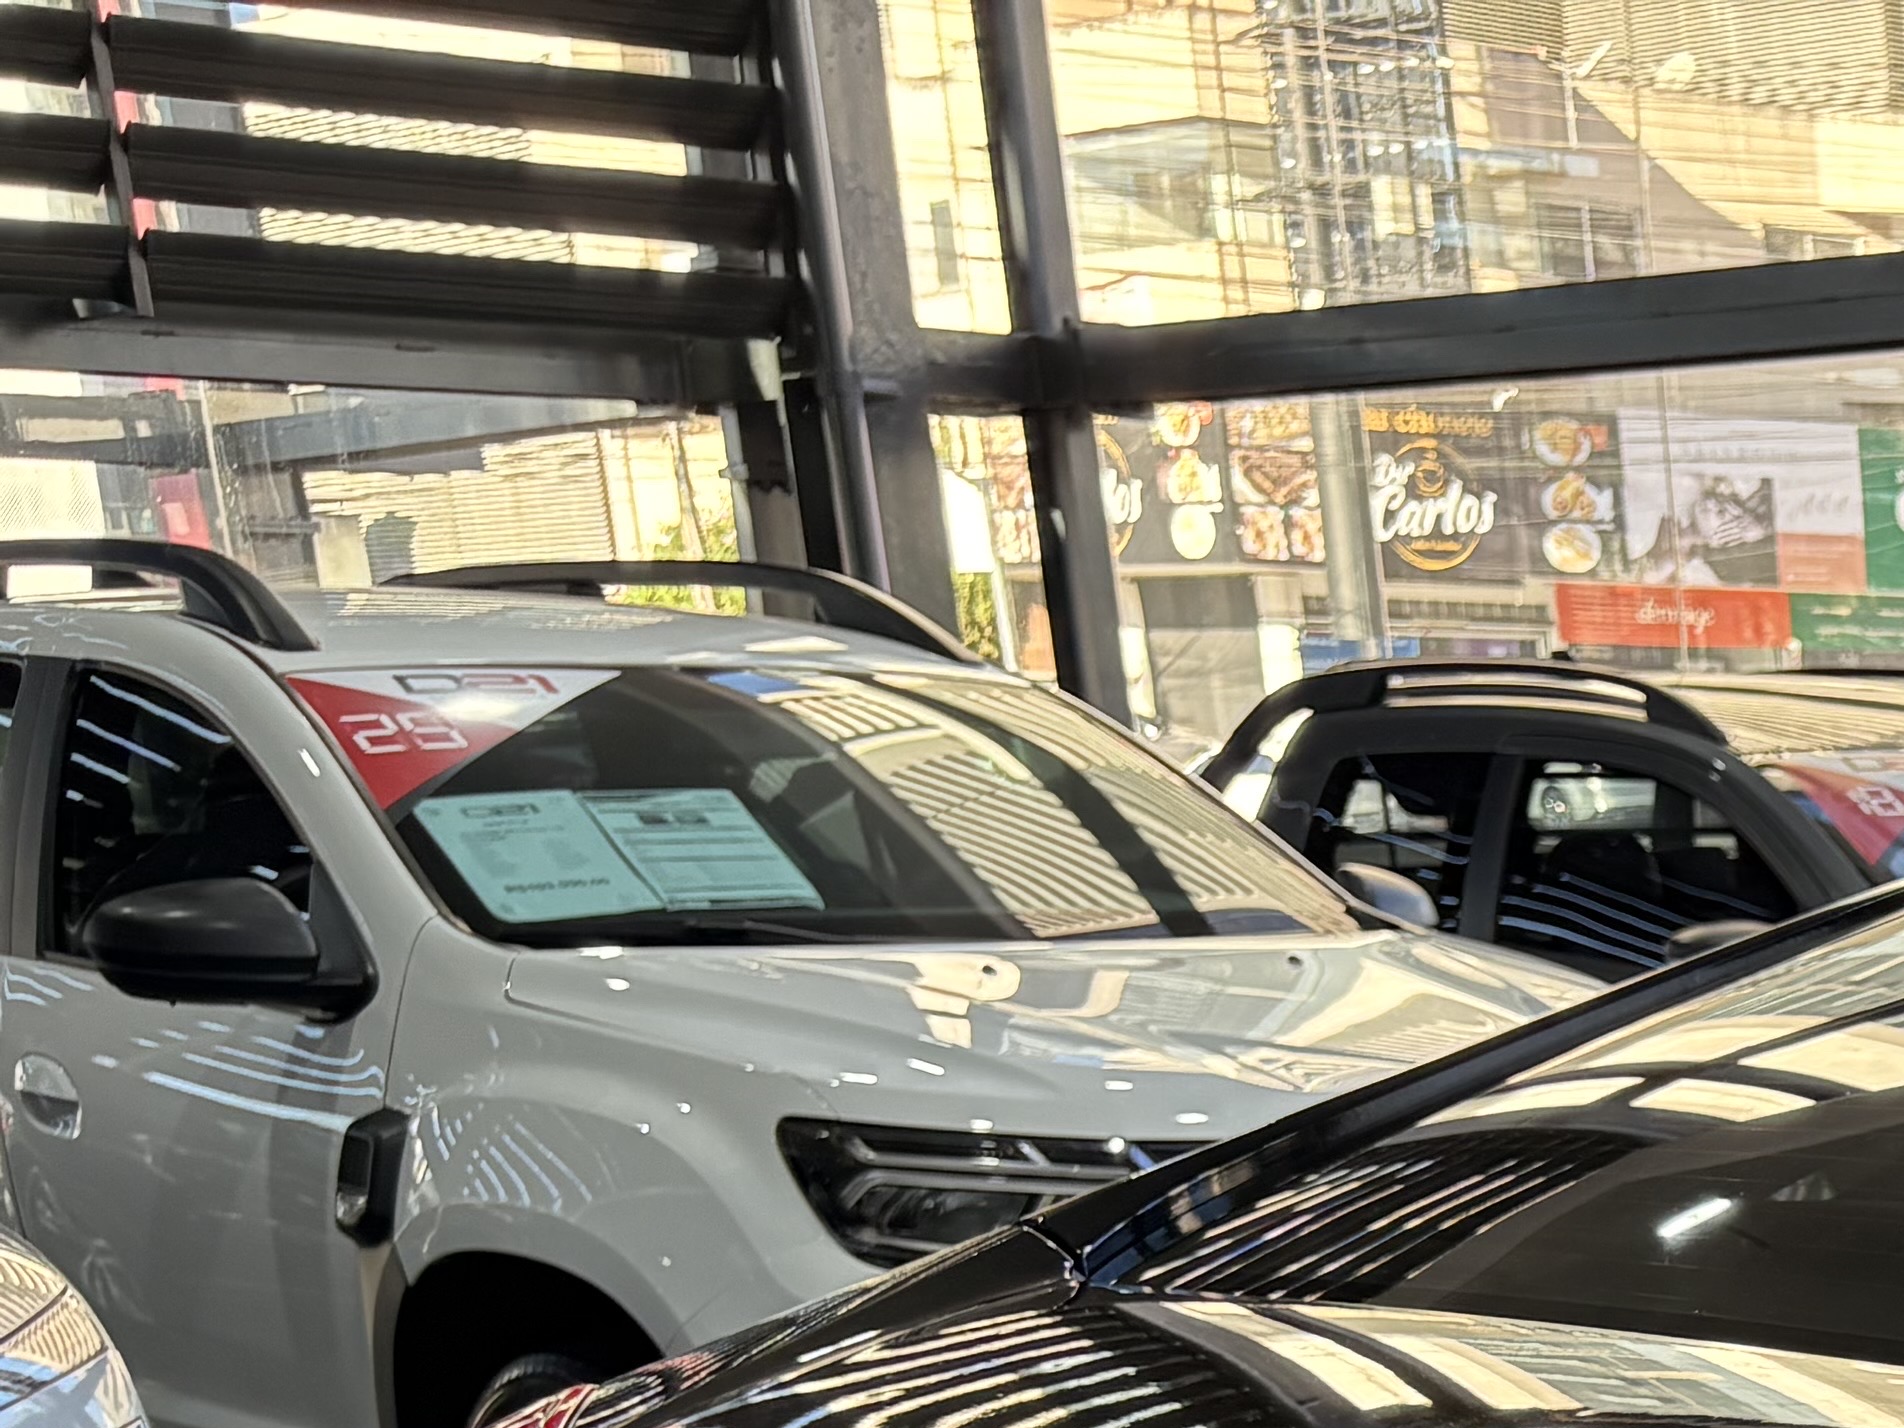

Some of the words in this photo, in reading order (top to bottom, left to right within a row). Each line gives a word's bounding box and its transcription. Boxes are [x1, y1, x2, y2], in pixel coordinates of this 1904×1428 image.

[1368, 474, 1499, 543] Carlos
[393, 673, 560, 694] D21
[339, 711, 469, 755] 25
